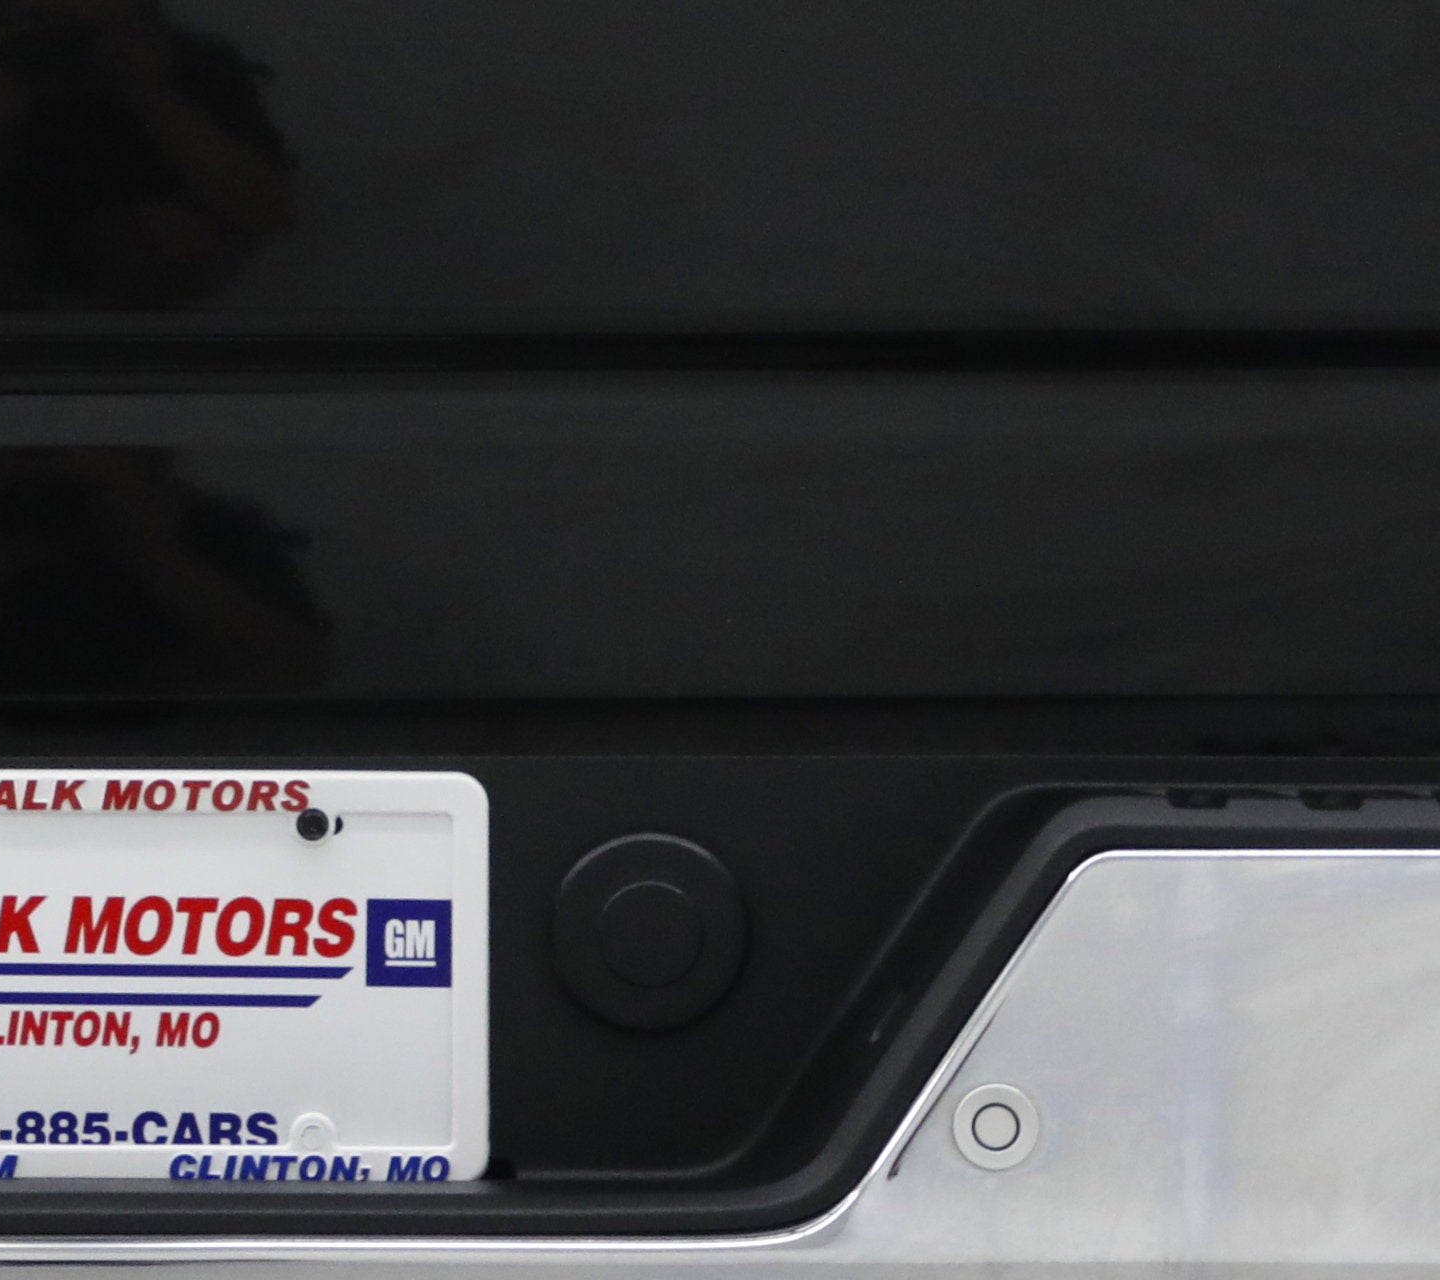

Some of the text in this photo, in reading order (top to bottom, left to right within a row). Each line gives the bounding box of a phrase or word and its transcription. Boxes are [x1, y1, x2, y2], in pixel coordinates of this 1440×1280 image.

[103, 779, 310, 812] MOTORS
[64, 896, 358, 958] MOTORS
[384, 920, 436, 960] GM
[156, 1012, 220, 1048] MO
[170, 1153, 450, 1182] CLINTON, MO
